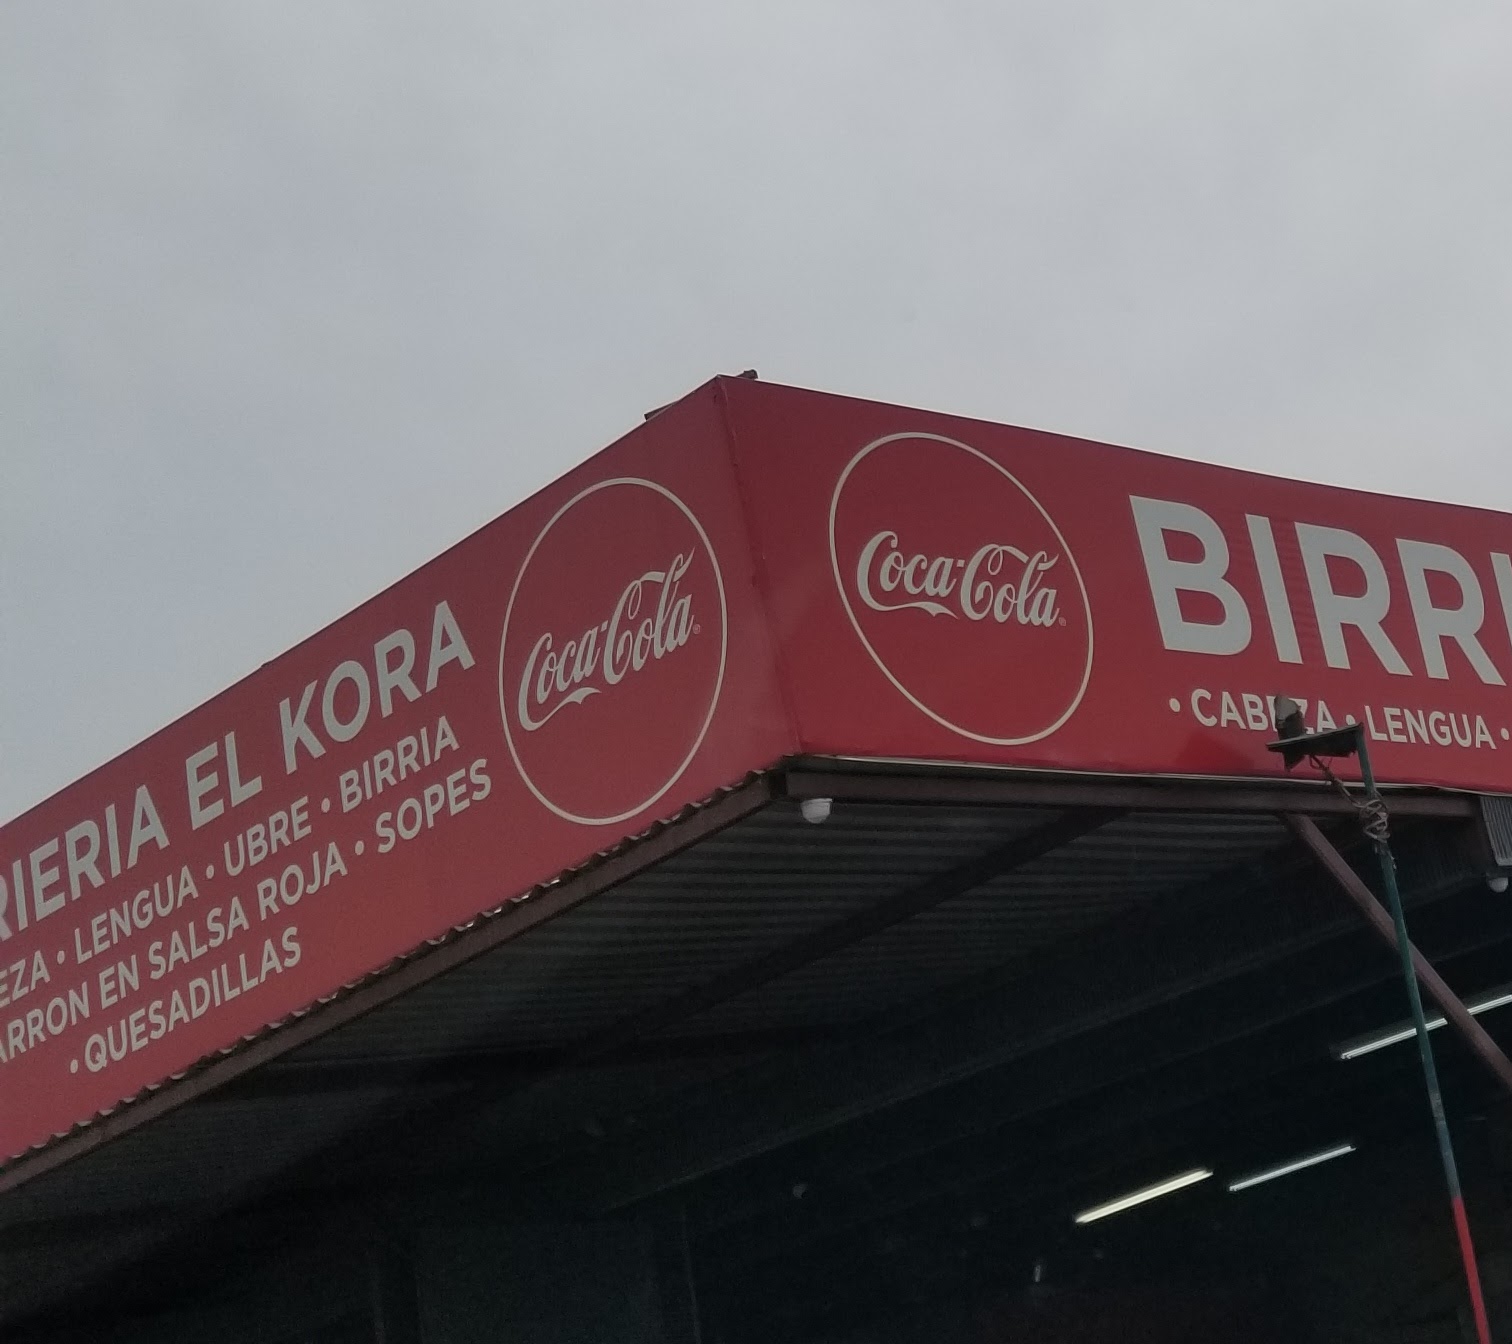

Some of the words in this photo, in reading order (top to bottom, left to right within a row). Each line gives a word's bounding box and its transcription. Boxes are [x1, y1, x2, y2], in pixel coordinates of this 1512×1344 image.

[185, 731, 262, 830] EL
[279, 600, 475, 774] KORA
[1365, 706, 1495, 748] LENGUA
[75, 865, 198, 964] LENGUA
[224, 796, 311, 876] UBRE
[339, 715, 459, 813] BIRRIA
[99, 954, 139, 1009] EN
[148, 896, 249, 980] SALSA
[257, 842, 347, 920] ROJA
[375, 758, 491, 853] SOPES
[84, 926, 301, 1072] QUESADILLAS
